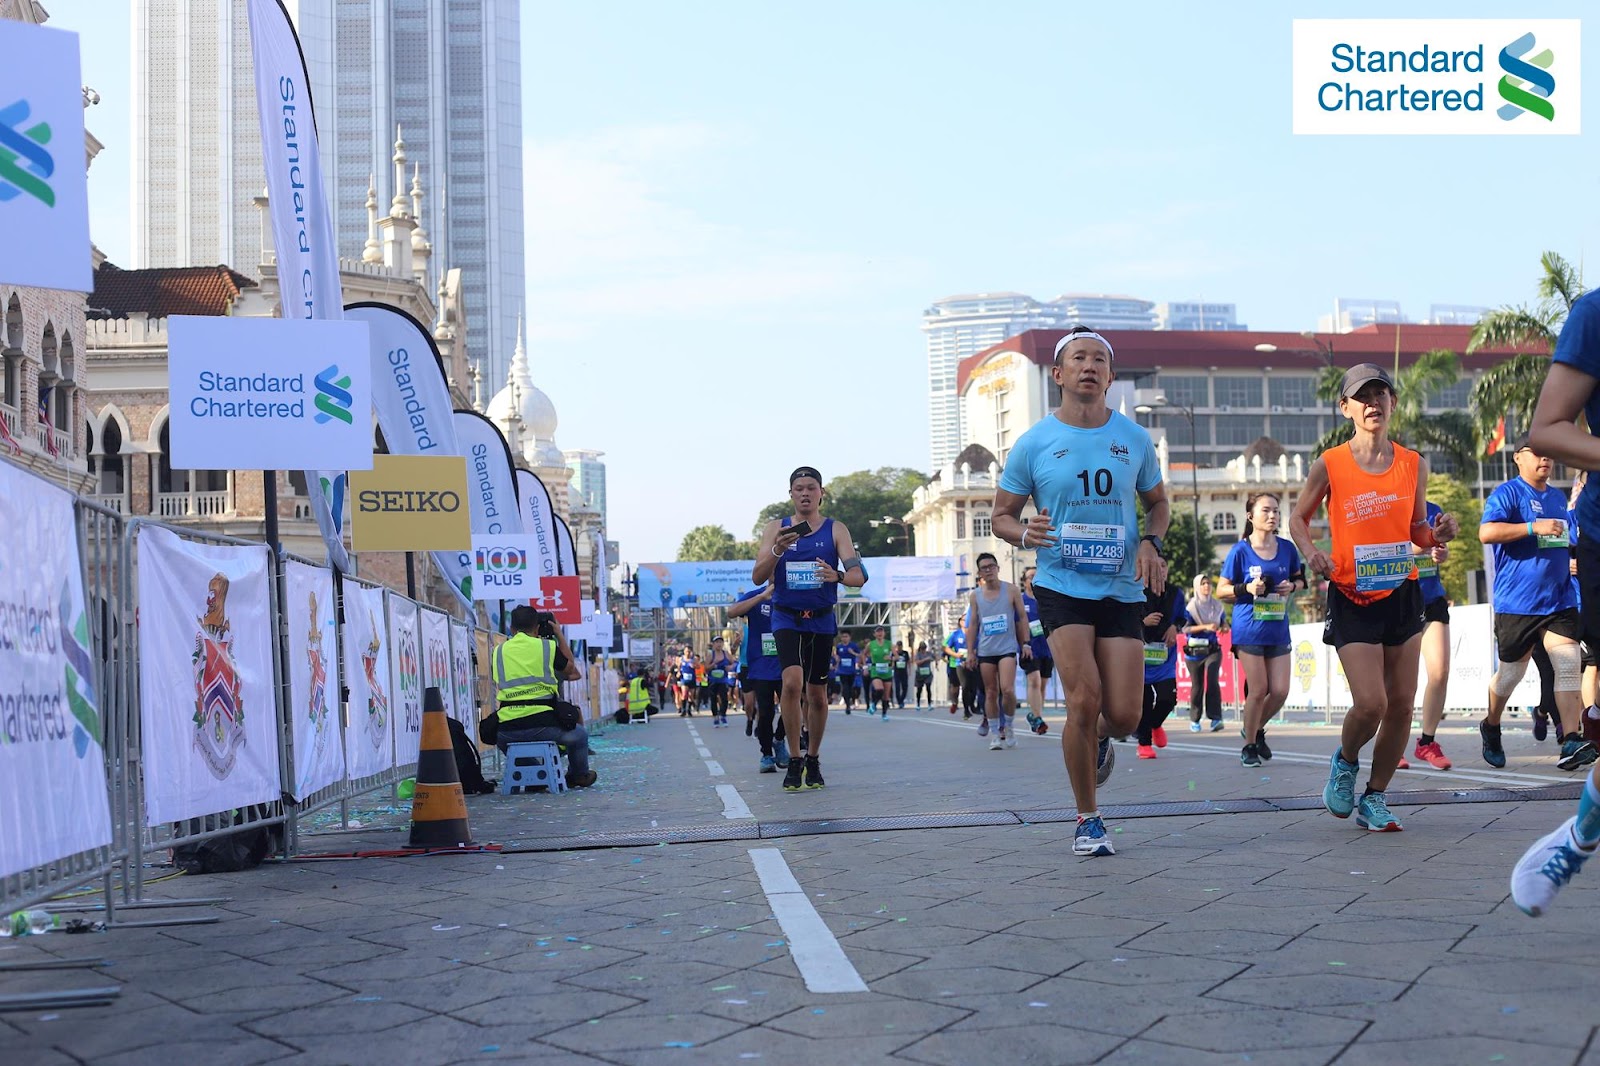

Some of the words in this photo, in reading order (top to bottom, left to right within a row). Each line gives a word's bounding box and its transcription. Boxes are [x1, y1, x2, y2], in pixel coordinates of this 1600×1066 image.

[280, 75, 311, 253] Standard
[199, 371, 304, 393] Standard
[190, 397, 304, 418] Chartered
[388, 348, 437, 450] Standard
[472, 443, 499, 518] Standard
[1077, 468, 1113, 497] 10
[359, 490, 460, 512] SEIKO
[1093, 499, 1123, 507] RUNNING
[1355, 491, 1378, 502] JOHOR
[1356, 493, 1398, 509] COUNTDOWN
[1358, 507, 1373, 517] RUN
[1374, 503, 1391, 513] 2016
[529, 495, 549, 556] Standard
[478, 546, 524, 573] 100
[1063, 543, 1123, 560] BM-12483
[787, 572, 824, 582] BM-113
[1358, 560, 1413, 577] DM-17479
[483, 574, 523, 586] PLUS
[0, 589, 56, 655] andard
[0, 680, 67, 744] artered
